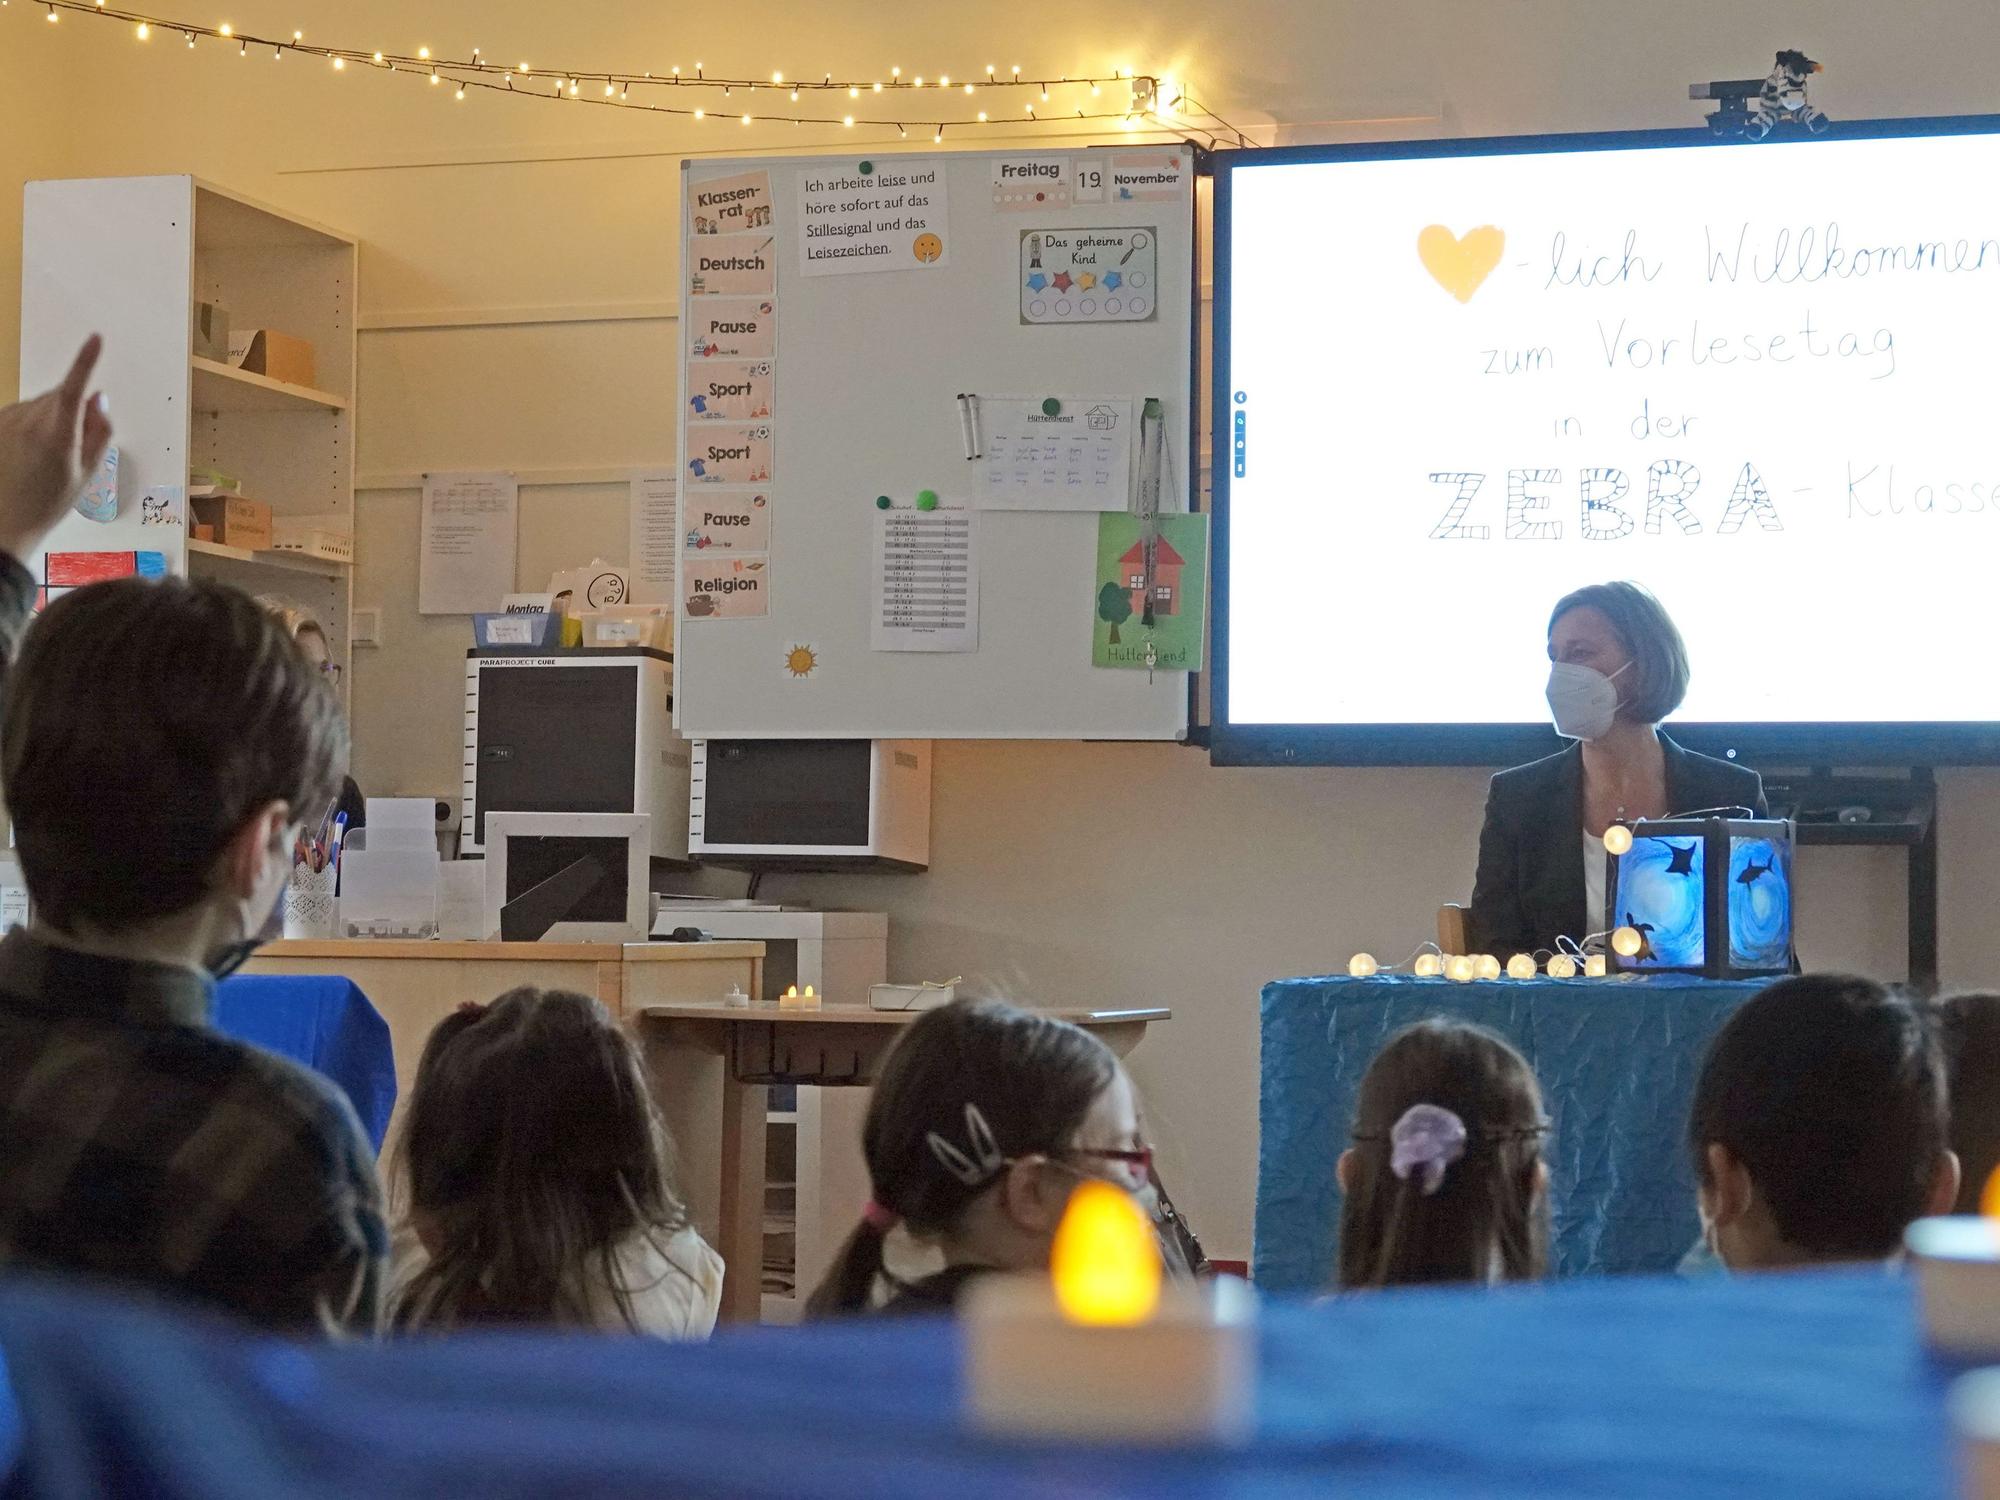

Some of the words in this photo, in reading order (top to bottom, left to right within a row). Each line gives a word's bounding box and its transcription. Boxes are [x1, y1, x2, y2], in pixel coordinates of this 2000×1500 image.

[1001, 163, 1060, 179] Freitag
[1114, 174, 1179, 185] November
[805, 180, 824, 192] Ich
[828, 177, 873, 190] arbeite
[878, 174, 907, 187] leise
[911, 171, 935, 185] und
[697, 186, 761, 207] Klassen-
[806, 202, 836, 214] höre
[840, 199, 881, 212] sofort
[884, 196, 904, 209] auf
[907, 194, 929, 207] das
[718, 204, 743, 219] rat
[806, 222, 872, 238] Stillesignal
[876, 219, 900, 232] und
[905, 217, 926, 230] das
[807, 243, 892, 260] Leisezeichen.
[1045, 236, 1068, 248] Das
[1076, 234, 1123, 252] geheime
[1072, 253, 1096, 265] Kind
[1705, 222, 2000, 283] Willkommen
[700, 257, 765, 271] Deutsch
[710, 320, 757, 334] Pause
[1480, 347, 1553, 375] zum
[1597, 309, 1896, 380] Vorlesetag
[709, 381, 752, 399] Sport
[1555, 415, 1582, 438] in
[1631, 398, 1697, 440] der
[708, 446, 751, 462] Sport
[703, 512, 750, 527] Pause
[694, 578, 758, 595] Religion
